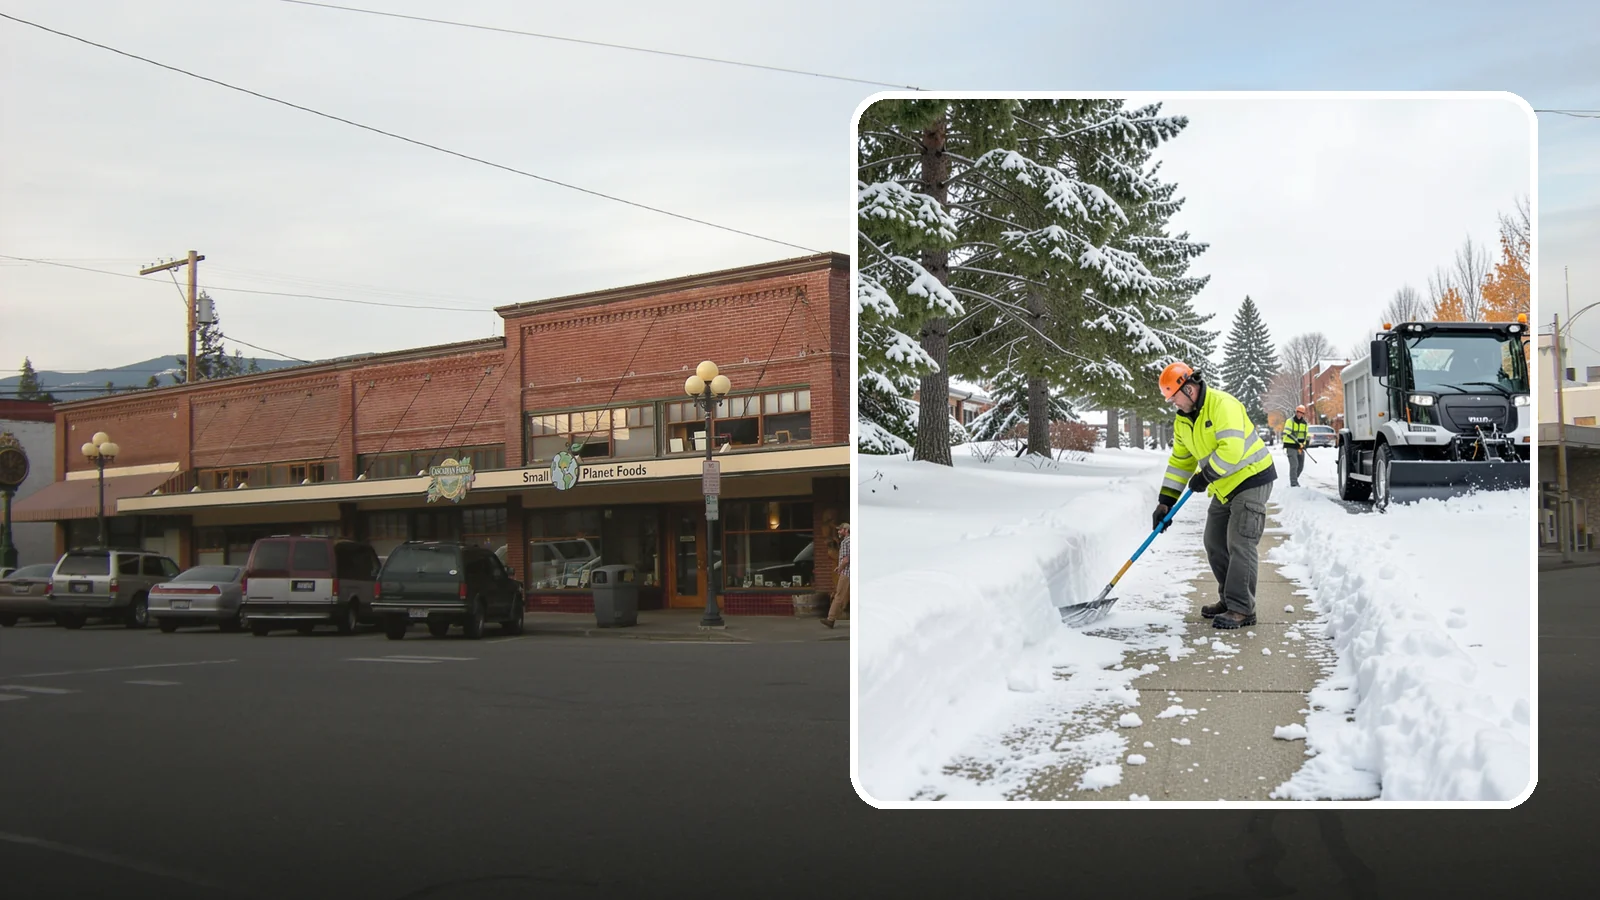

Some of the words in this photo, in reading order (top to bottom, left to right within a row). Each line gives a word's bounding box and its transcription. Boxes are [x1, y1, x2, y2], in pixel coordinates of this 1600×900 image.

[523, 471, 549, 482] Small
[582, 468, 614, 478] Planet
[617, 465, 647, 476] Foods
